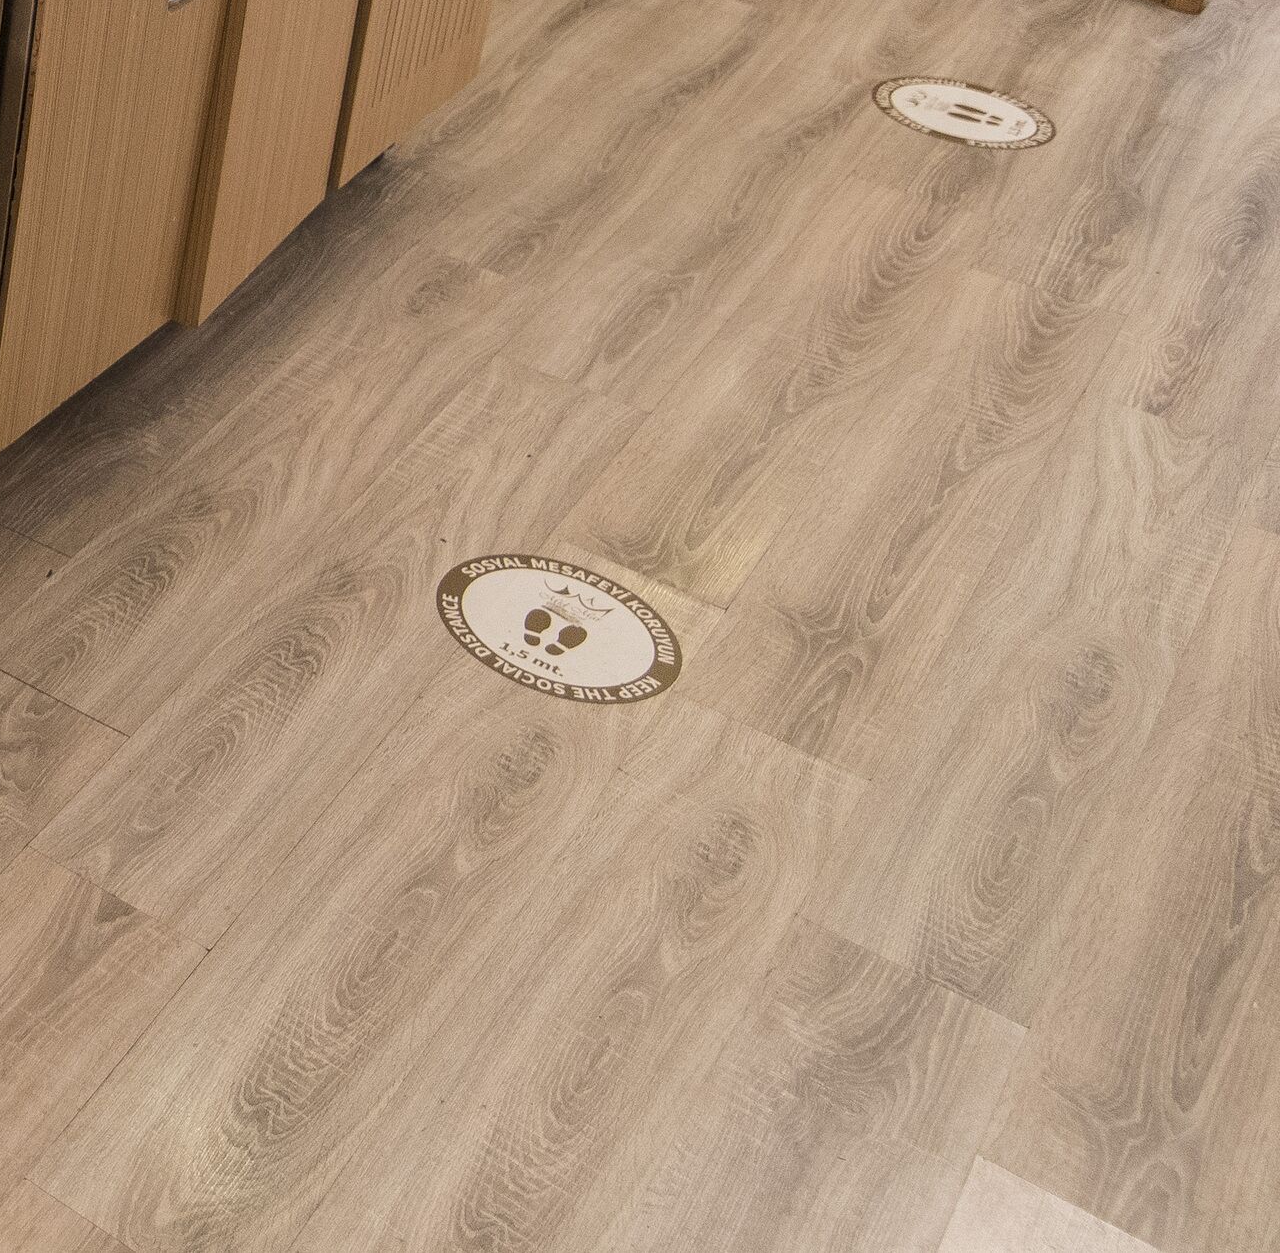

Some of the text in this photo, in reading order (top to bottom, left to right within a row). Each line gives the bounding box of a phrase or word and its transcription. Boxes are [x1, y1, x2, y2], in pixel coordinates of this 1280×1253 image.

[442, 593, 662, 701] KEEP THE SOCIAL DISTANCE
[461, 557, 528, 578] SOSYAL
[530, 558, 631, 601] MESAFEYİ
[627, 599, 675, 666] KORUYUN
[498, 642, 564, 677] 1,5 mt.
